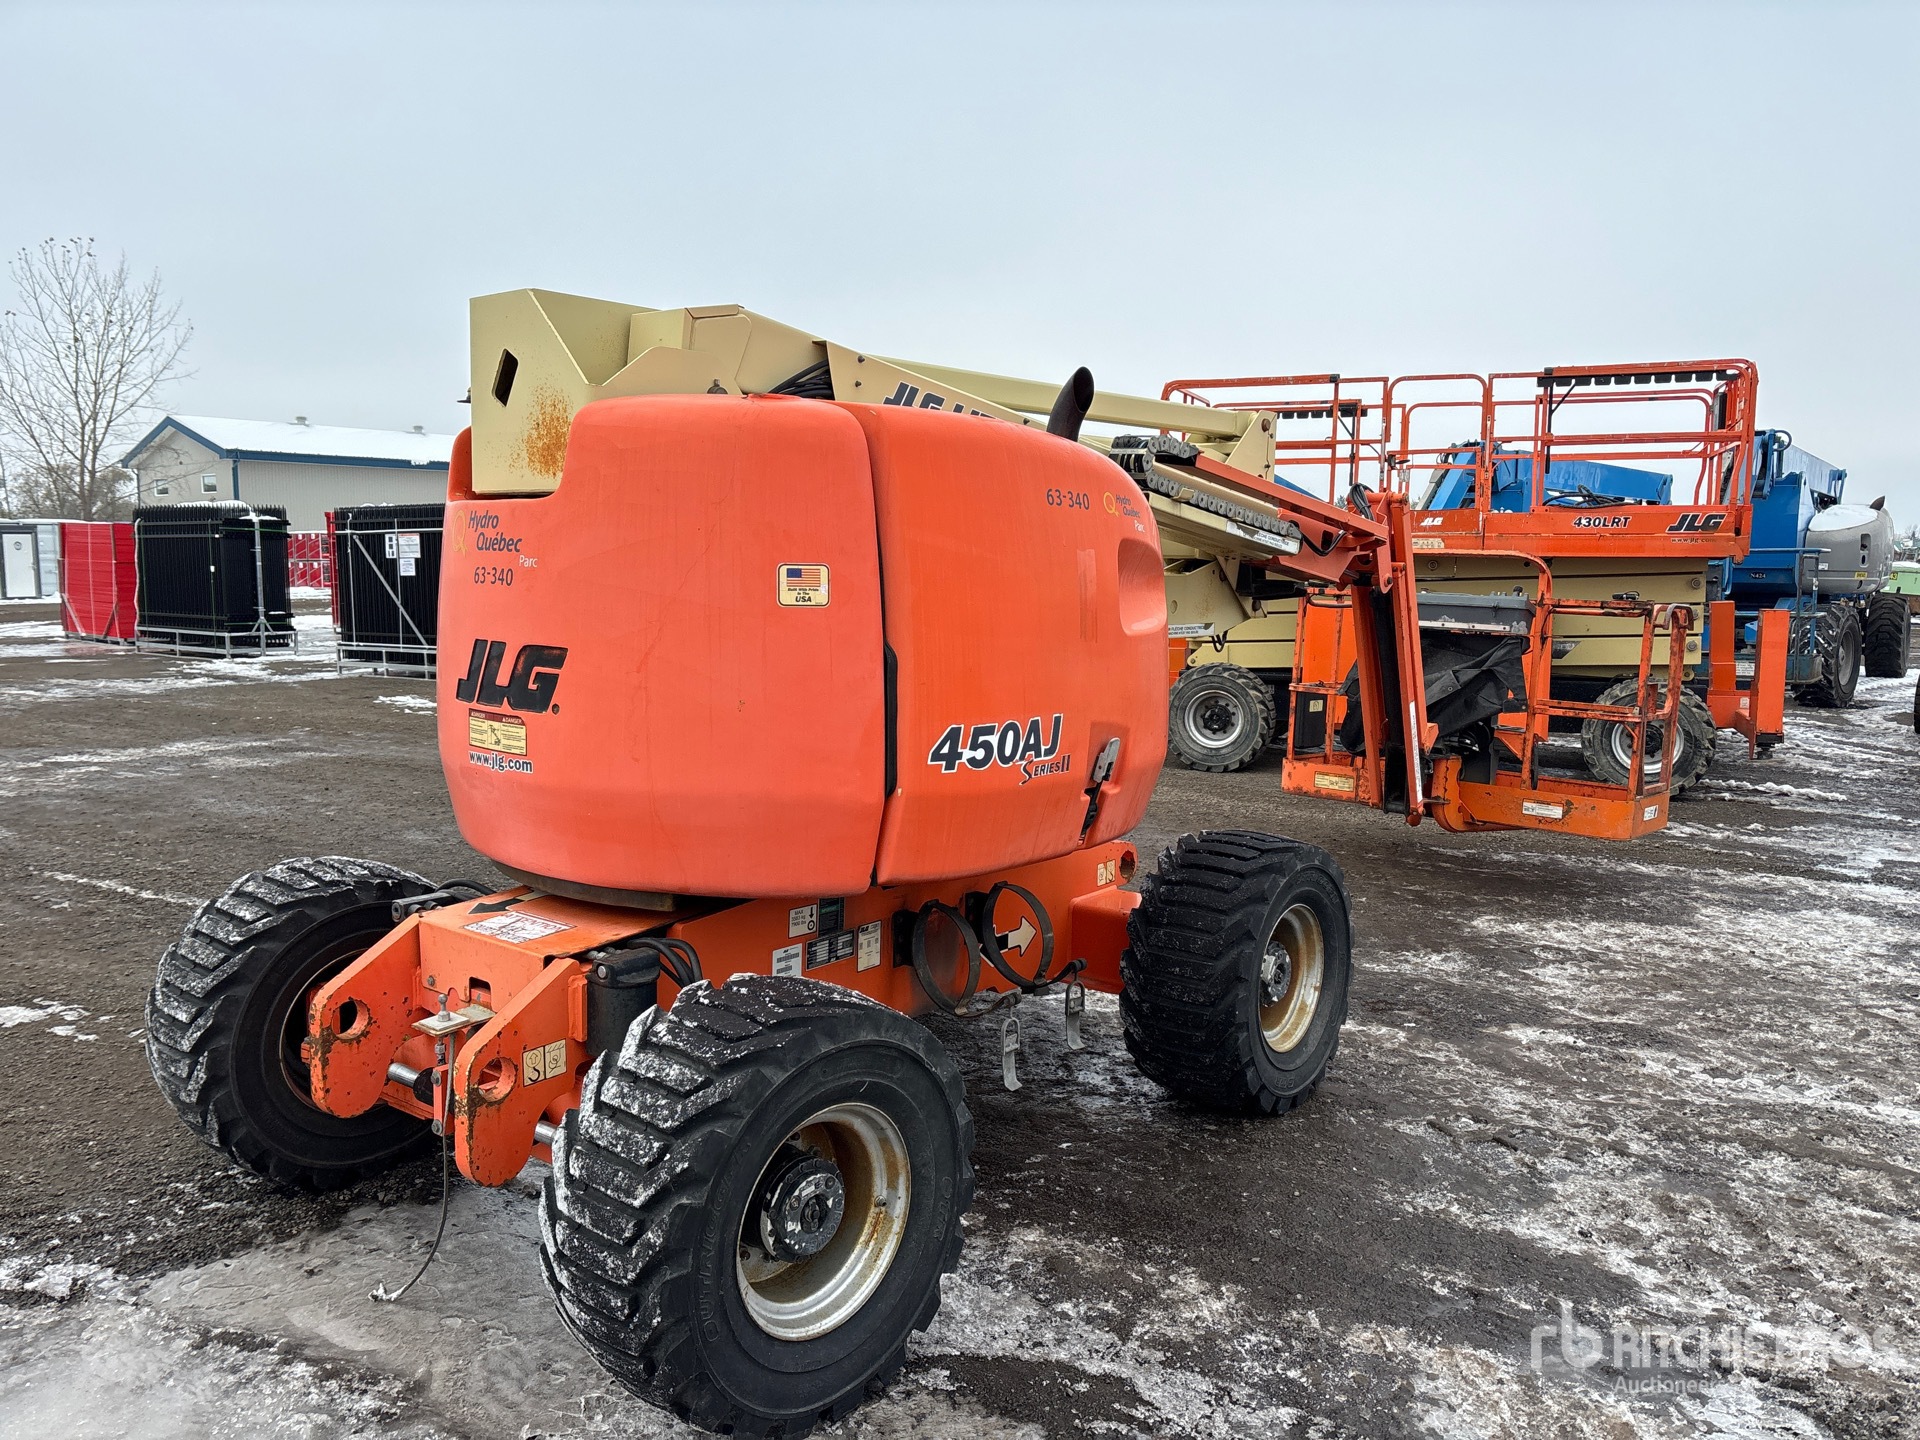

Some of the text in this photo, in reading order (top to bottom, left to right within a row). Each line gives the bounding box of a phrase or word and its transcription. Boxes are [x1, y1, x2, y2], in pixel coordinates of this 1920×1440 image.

[1046, 488, 1090, 510] 63-340
[1116, 495, 1132, 507] Hydro
[468, 510, 499, 532] Hydro
[1573, 516, 1631, 528] 430LRT
[1666, 513, 1727, 533] JLG
[476, 532, 522, 552] Québec
[519, 555, 538, 567] Parc
[474, 566, 513, 586] 63-340
[456, 639, 569, 714] JLG
[928, 714, 1063, 773] 450AJ
[468, 751, 533, 773] www.jlg.com
